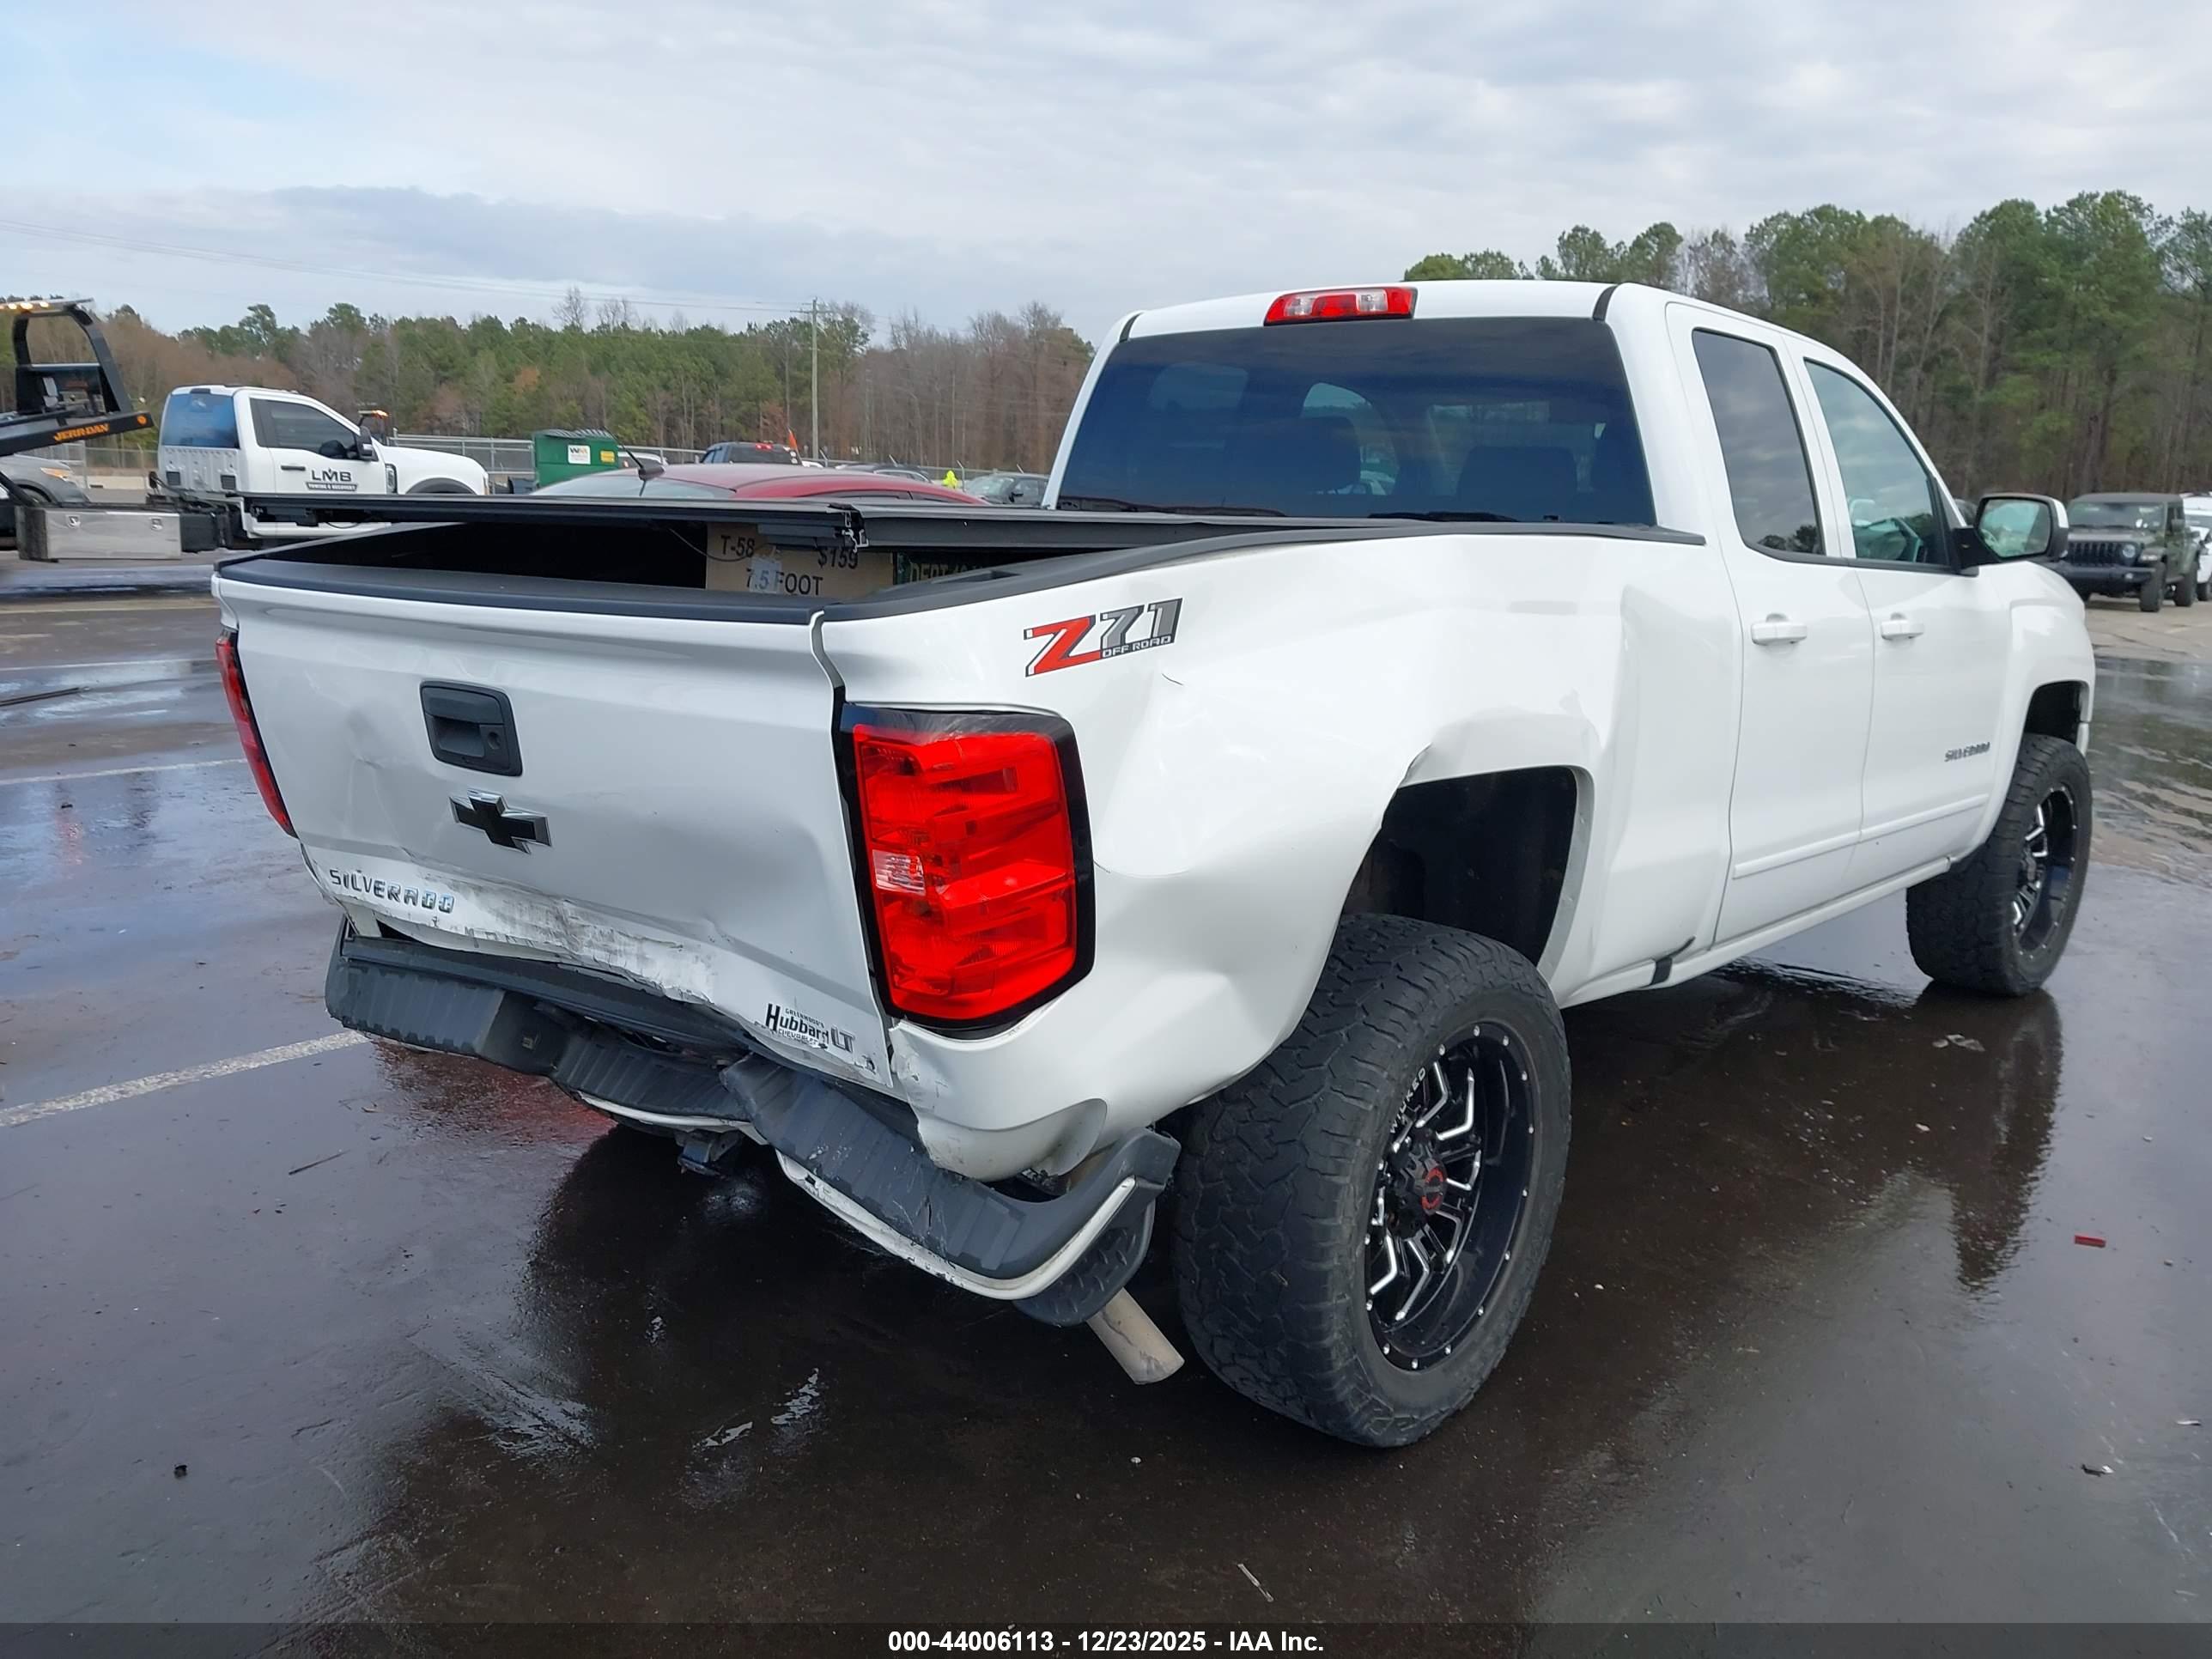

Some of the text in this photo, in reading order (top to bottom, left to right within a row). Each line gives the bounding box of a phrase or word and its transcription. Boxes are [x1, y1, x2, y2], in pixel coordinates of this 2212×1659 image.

[311, 469, 352, 482] LMB
[720, 534, 756, 558] T-58
[775, 572, 823, 596] FOOT
[1023, 597, 1183, 678] Z71
[1102, 635, 1173, 659] OFF ROAD
[330, 868, 455, 915] SILVERADO
[765, 1002, 830, 1046] Hubbard
[830, 1025, 855, 1054] LT
